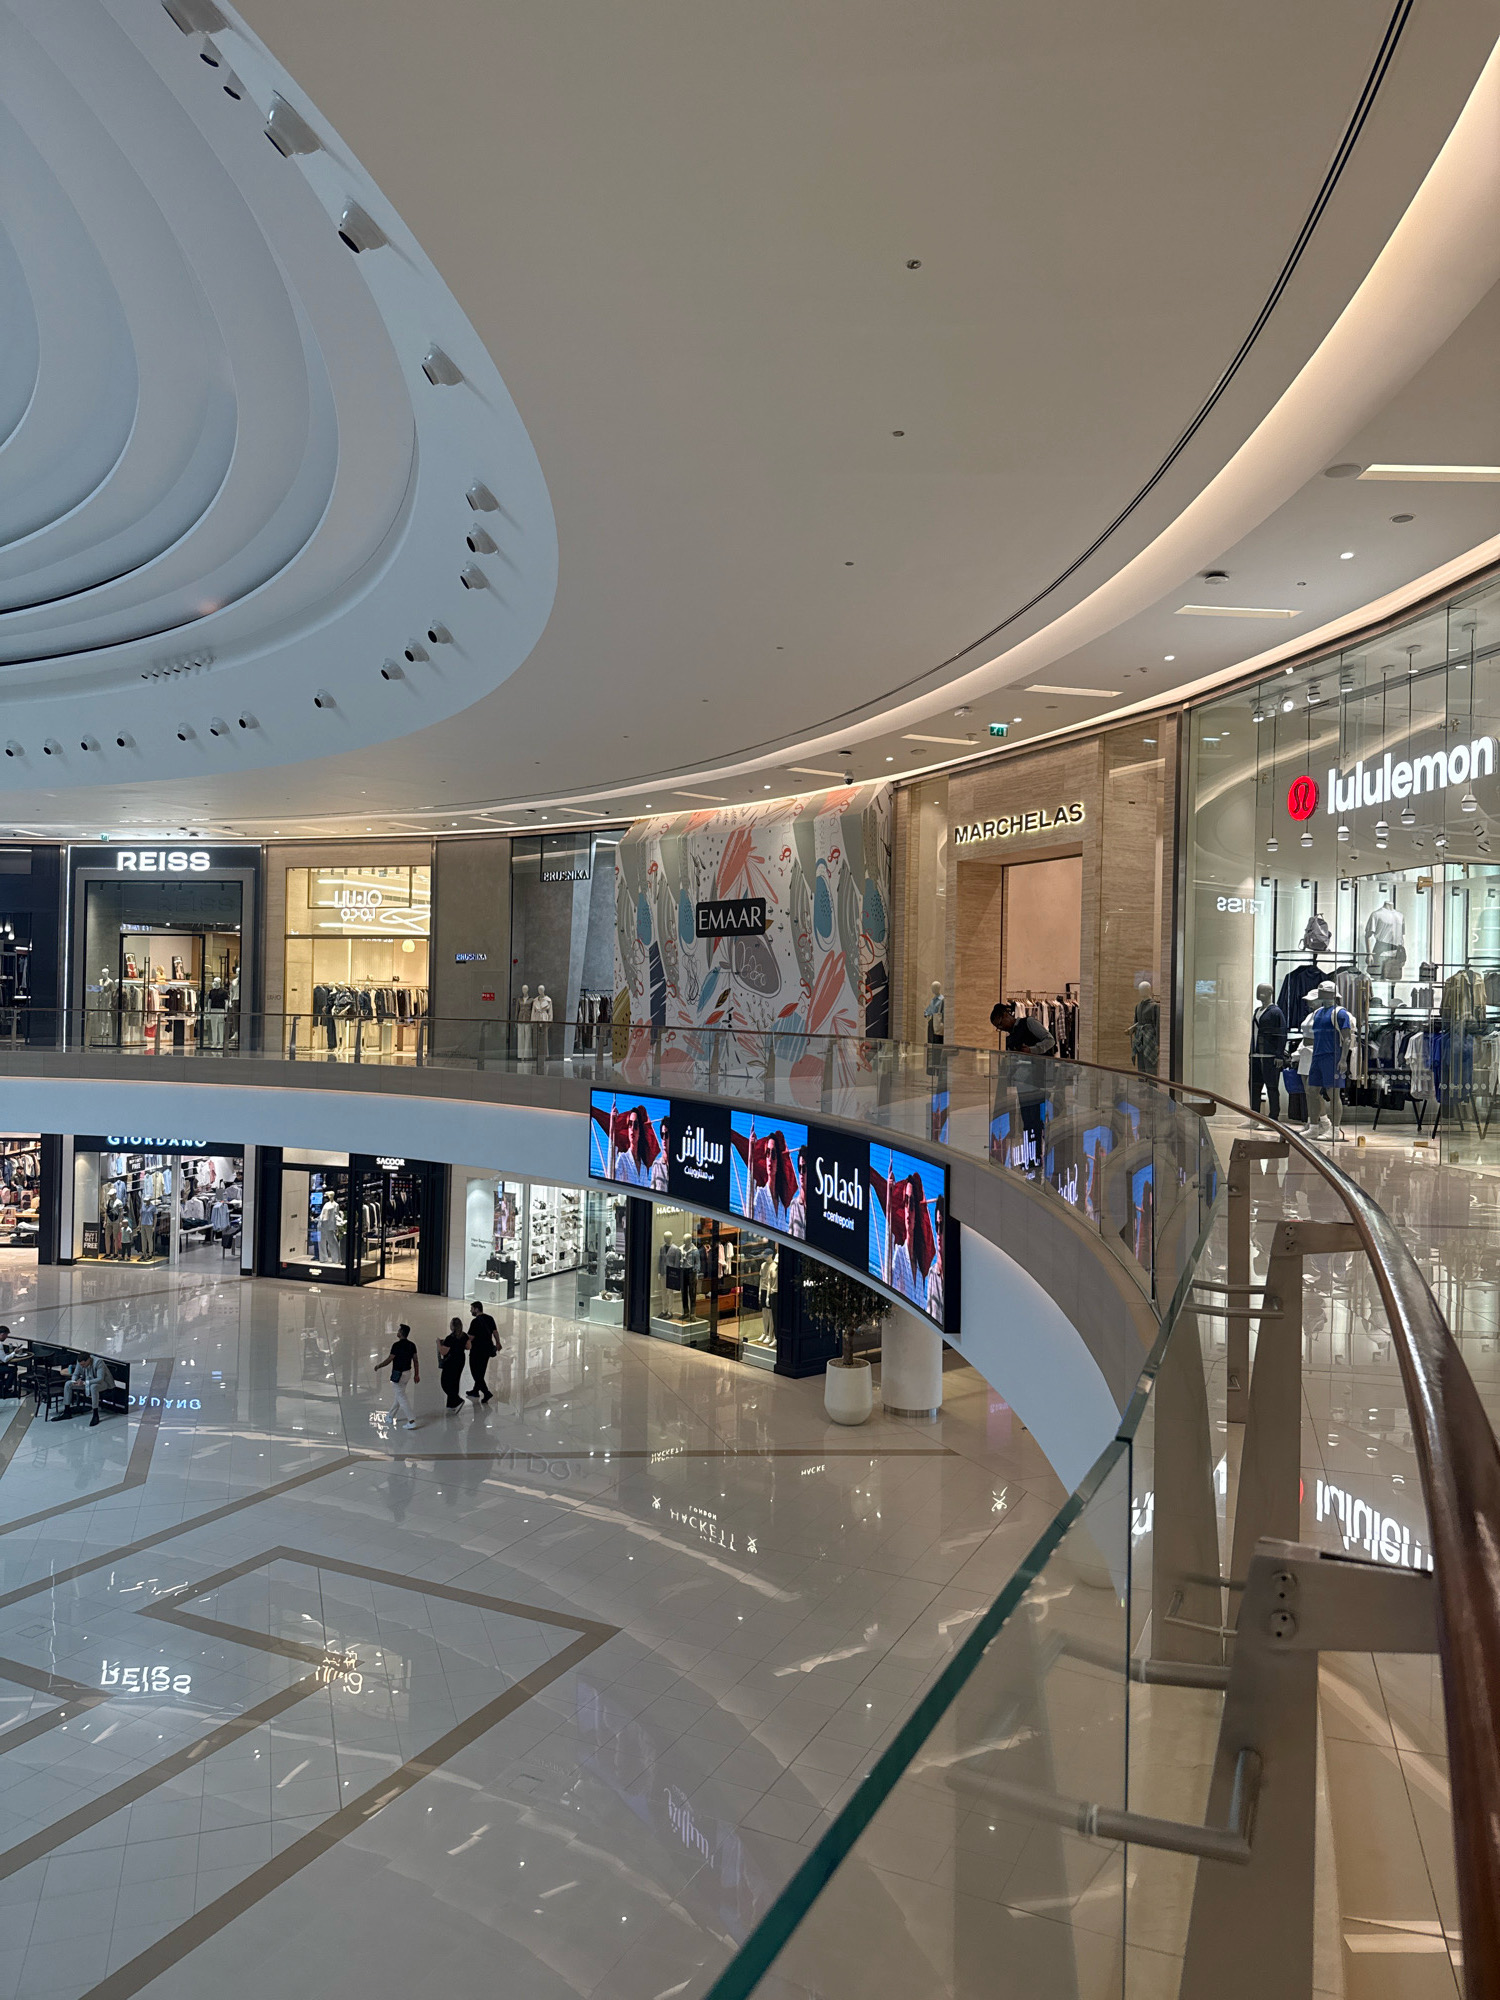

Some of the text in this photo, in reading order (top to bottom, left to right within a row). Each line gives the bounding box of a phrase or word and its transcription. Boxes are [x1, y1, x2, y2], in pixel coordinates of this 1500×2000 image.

[1327, 735, 1499, 815] lululemon
[954, 802, 1086, 845] MARCHELAS
[116, 851, 211, 872] REISS
[698, 904, 762, 931] EMAAR
[676, 1125, 724, 1168] سبلاش
[815, 1156, 863, 1211] Splash
